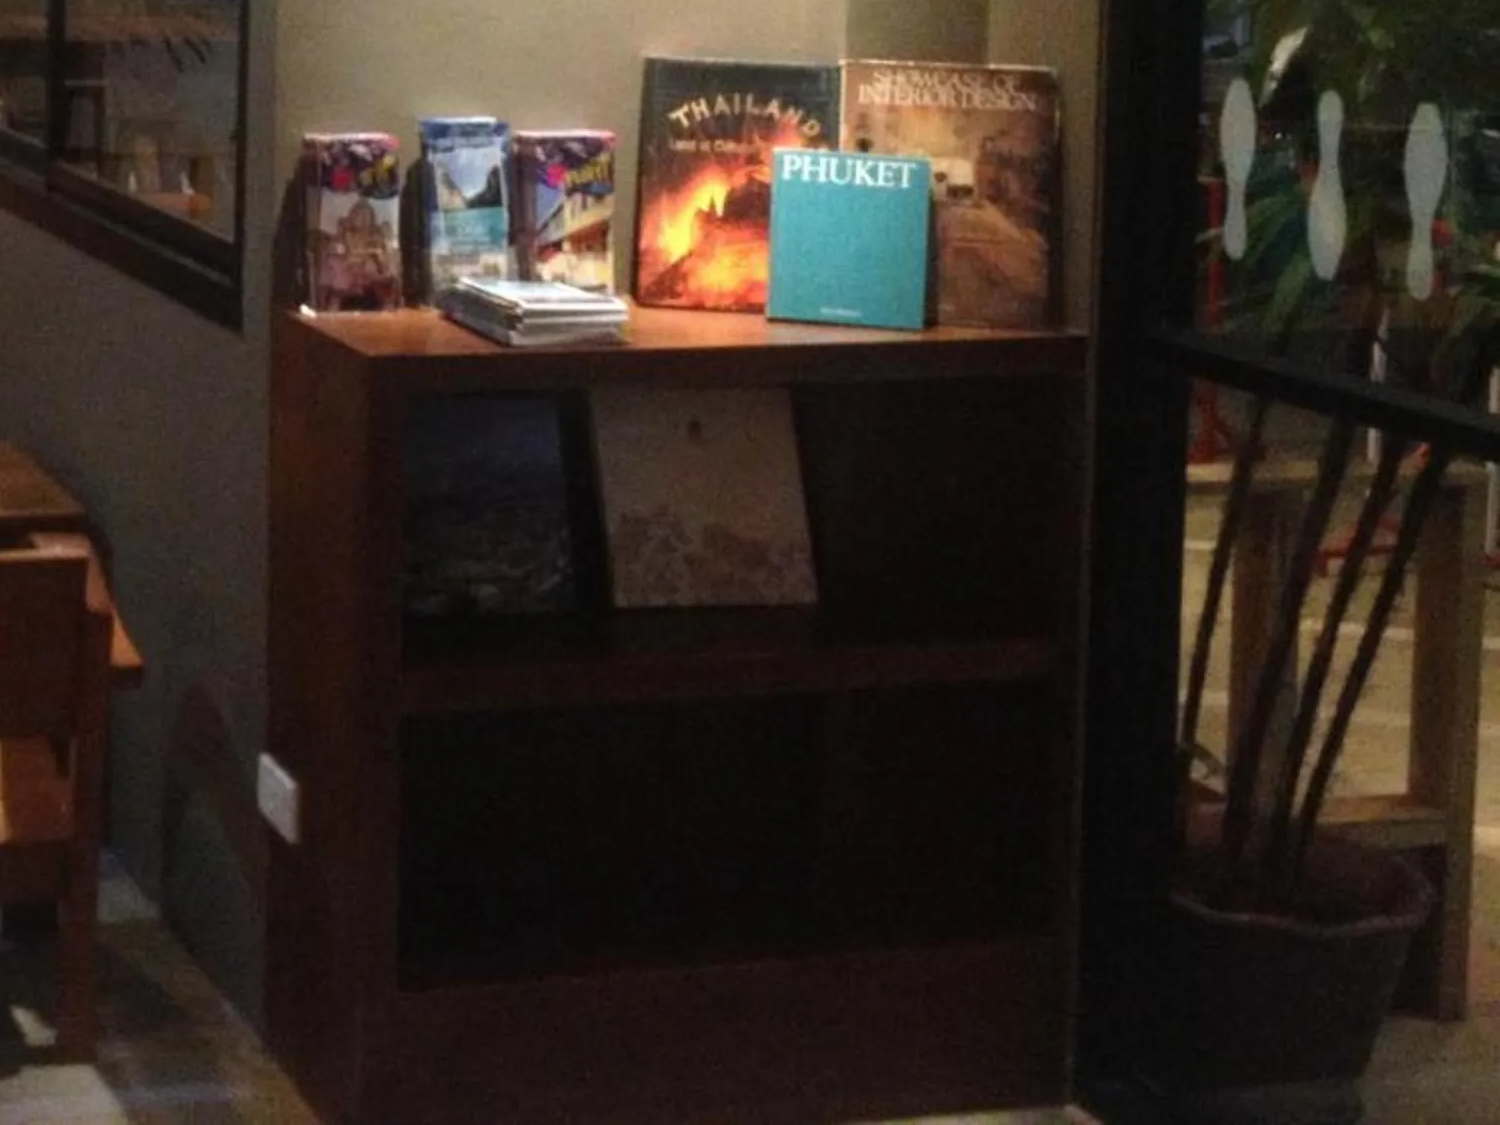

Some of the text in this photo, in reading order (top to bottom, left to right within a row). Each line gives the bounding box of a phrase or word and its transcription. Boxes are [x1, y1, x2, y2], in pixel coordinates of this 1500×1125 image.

[667, 92, 821, 137] THAILAND
[857, 83, 1037, 112] INTERIOR DESIGN
[781, 153, 917, 189] PHUKET
